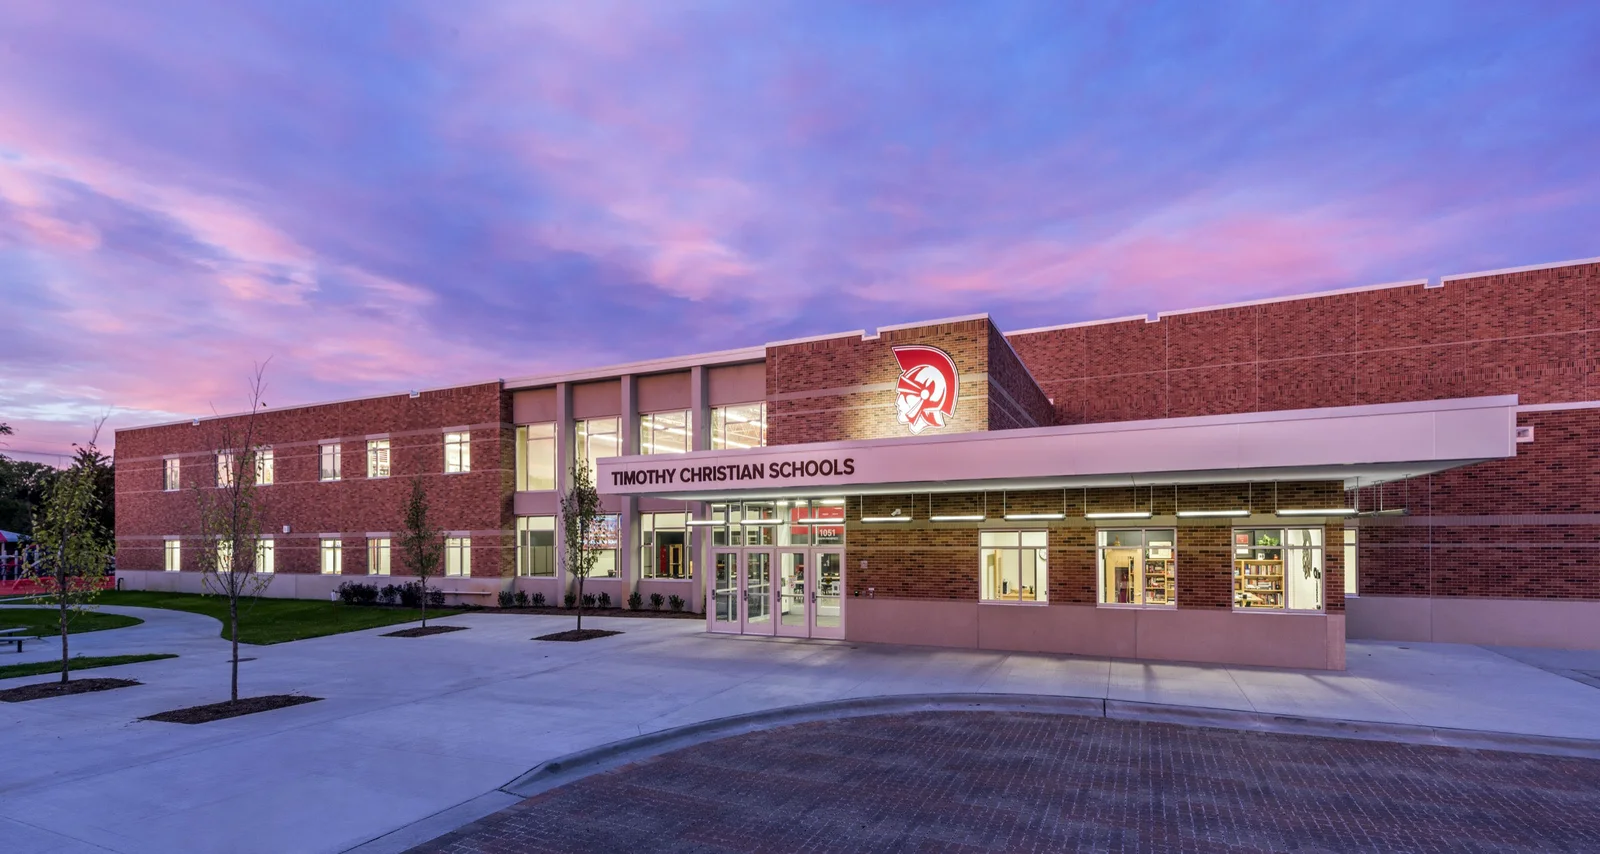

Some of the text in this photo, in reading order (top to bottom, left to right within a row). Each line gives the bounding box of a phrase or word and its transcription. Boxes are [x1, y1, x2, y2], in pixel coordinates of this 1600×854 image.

[611, 458, 855, 486] TIMOTHY CHRISTIAN SCHOOLS
[819, 528, 836, 537] 1051
